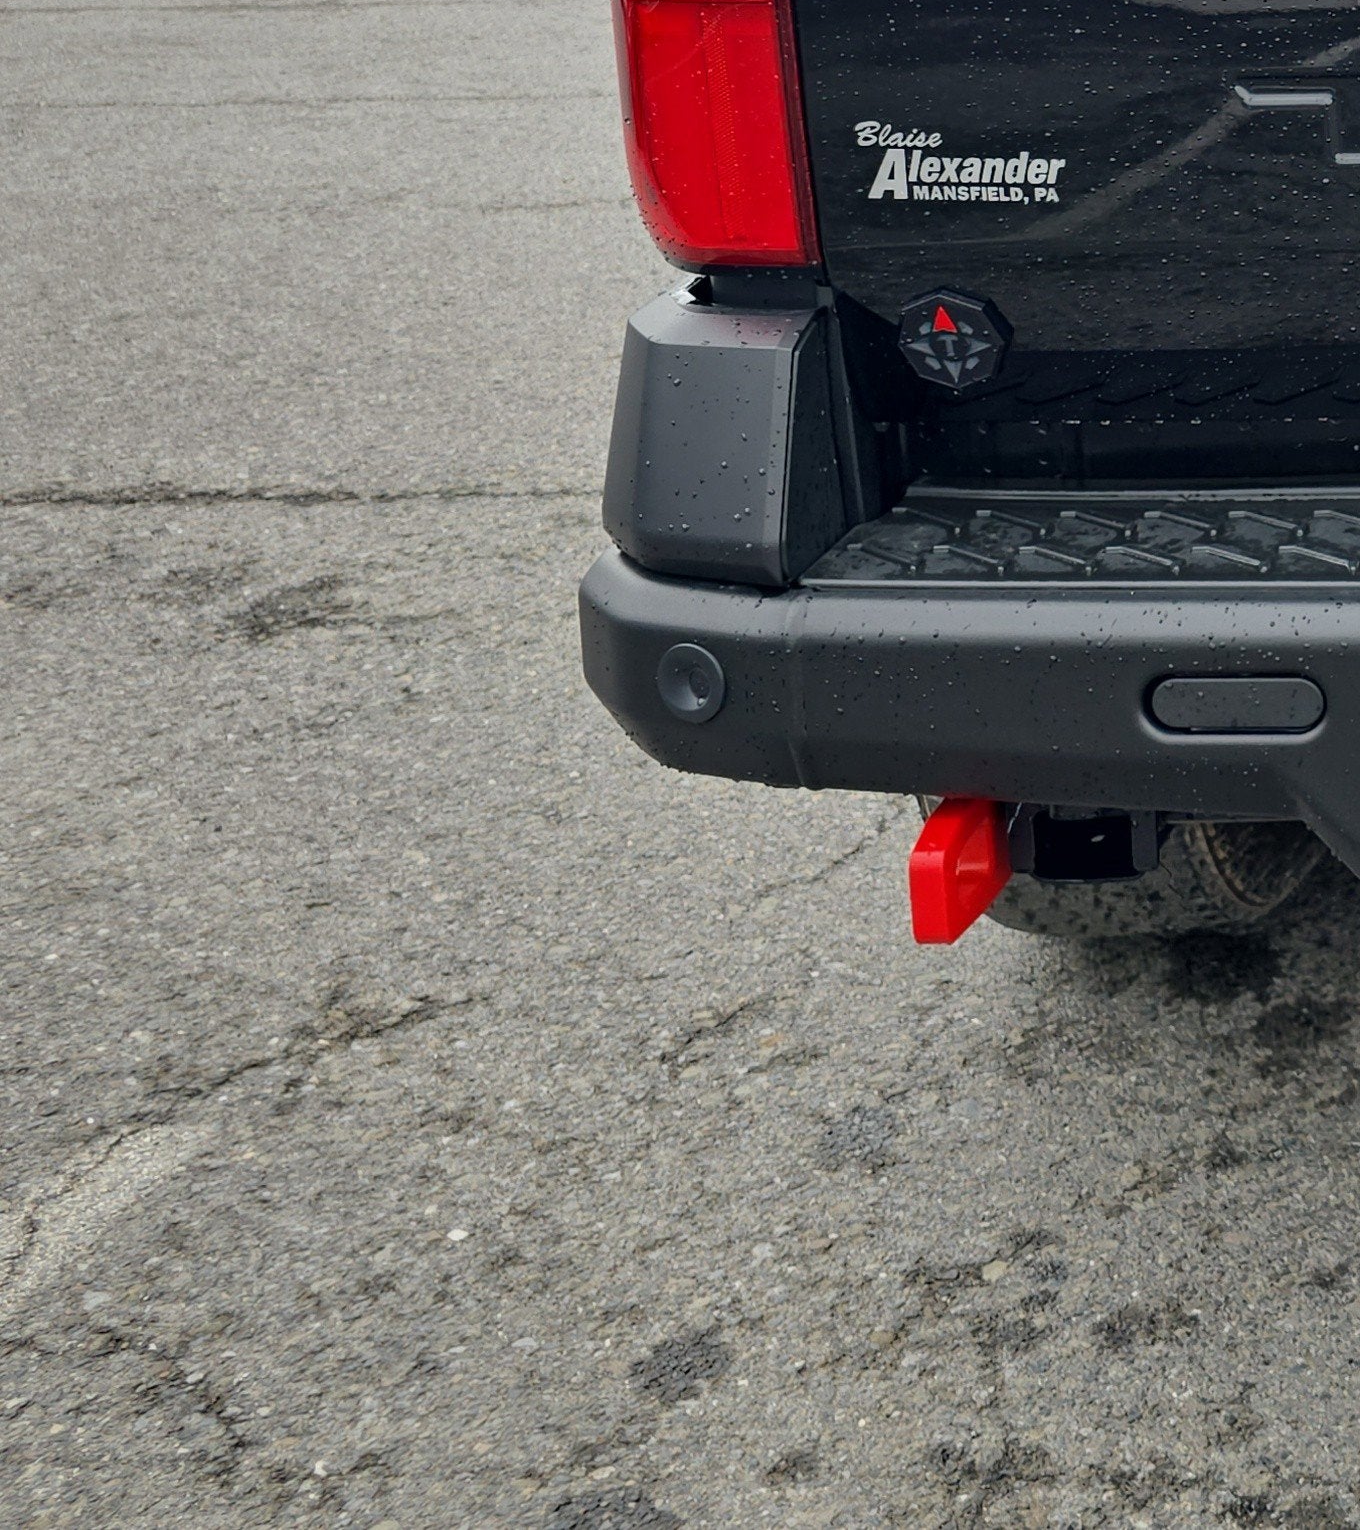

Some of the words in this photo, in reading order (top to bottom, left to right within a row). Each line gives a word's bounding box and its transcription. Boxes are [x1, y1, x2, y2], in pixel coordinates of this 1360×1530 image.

[853, 120, 943, 148] Blaise
[868, 148, 1066, 200] Alexander
[913, 185, 1030, 205] MANSFIELD,
[1034, 187, 1060, 202] PA
